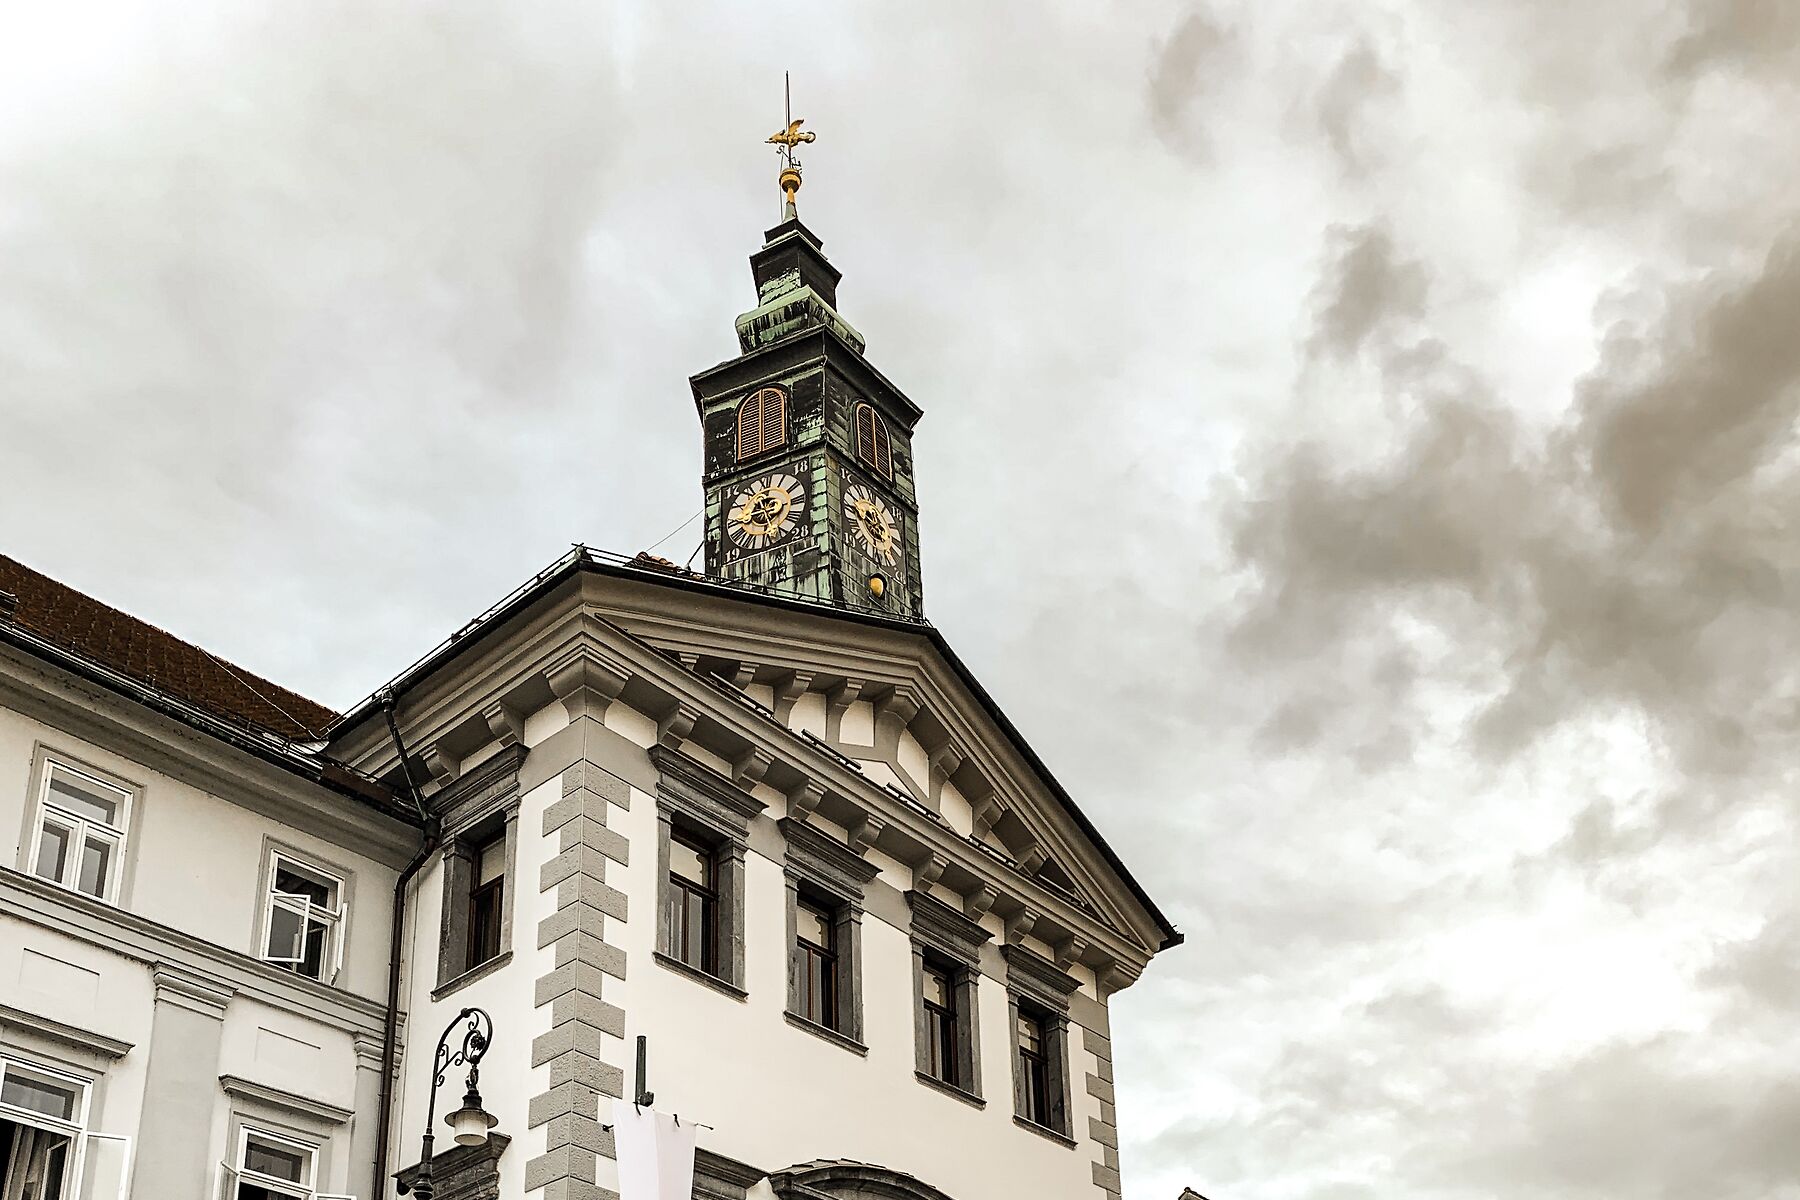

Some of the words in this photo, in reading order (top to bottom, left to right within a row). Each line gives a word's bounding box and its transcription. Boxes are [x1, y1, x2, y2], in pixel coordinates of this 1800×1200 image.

[794, 460, 808, 475] 18
[725, 548, 740, 562] 19
[791, 524, 809, 541] 28
